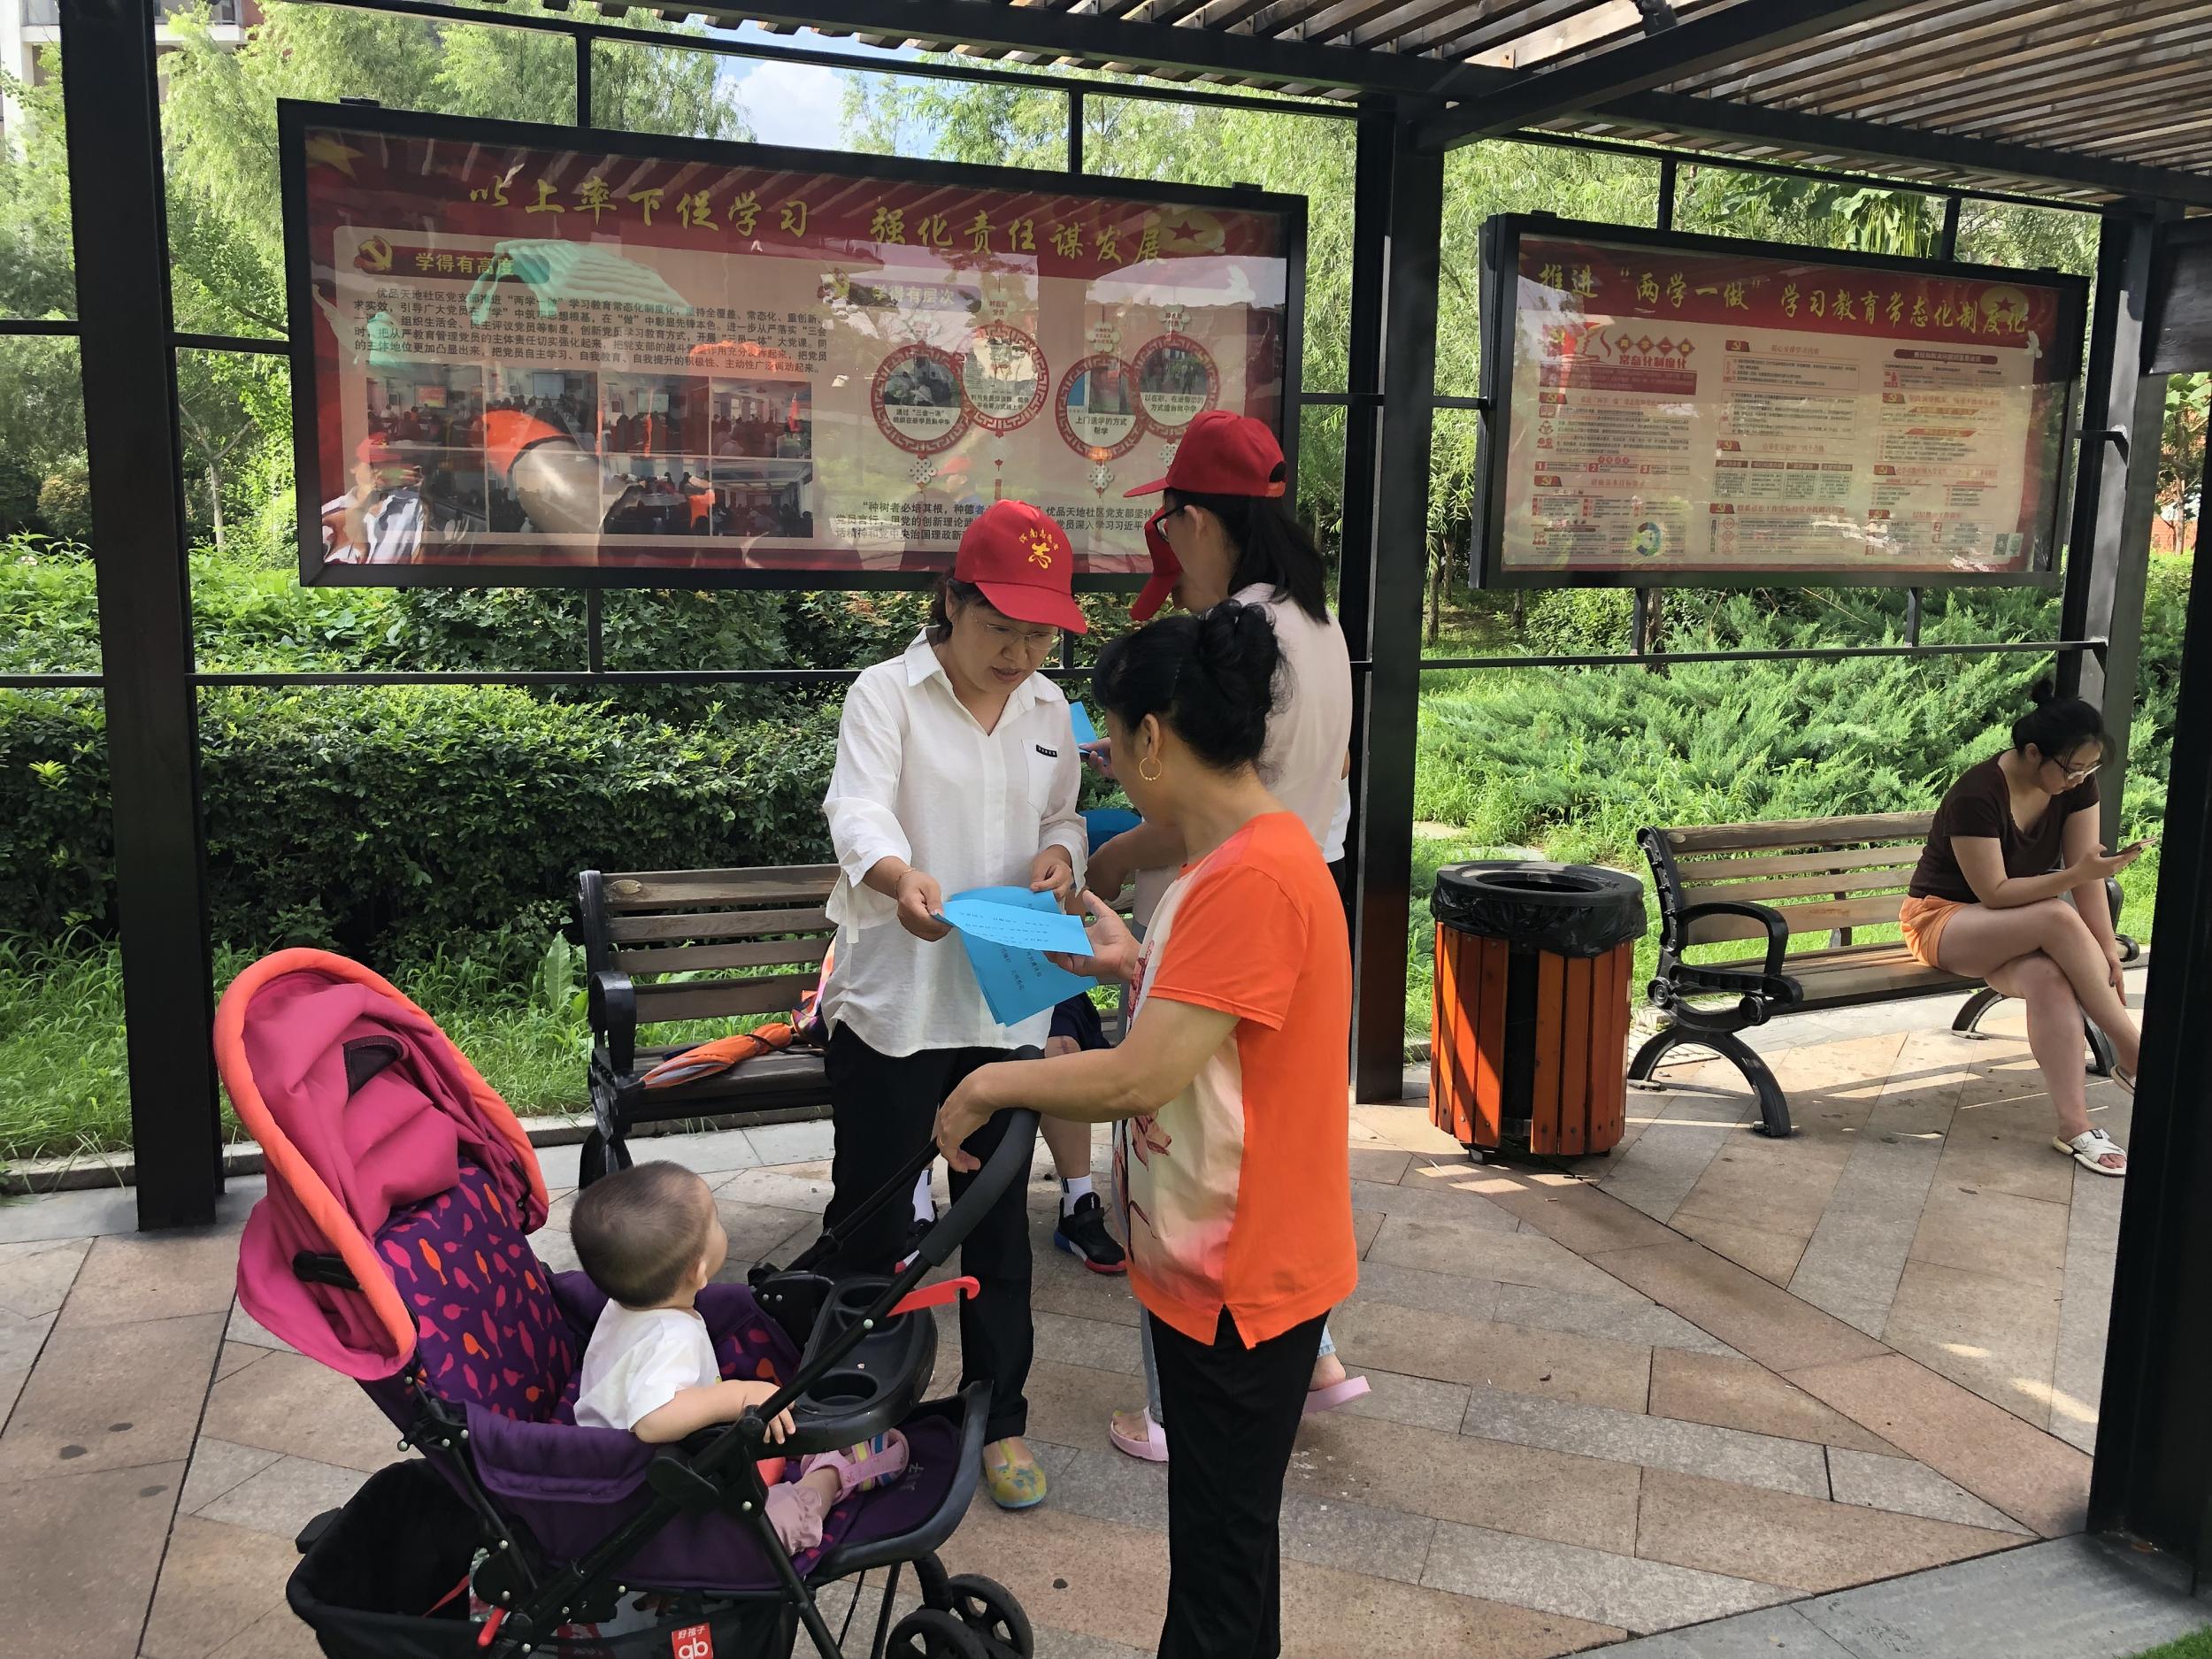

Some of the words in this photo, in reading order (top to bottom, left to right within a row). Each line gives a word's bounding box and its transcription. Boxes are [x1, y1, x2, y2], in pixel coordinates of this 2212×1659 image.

[470, 174, 807, 237] 以上率下促学习
[870, 206, 1163, 266] 强化责任谋发展
[416, 252, 513, 276] 学得有高度
[874, 283, 955, 305] 学得有层次
[863, 501, 989, 515] “种树者必培其根，种德者
[835, 526, 964, 541] 话精神和党中央治国理政新
[678, 1625, 705, 1640] 好孩子
[678, 1637, 709, 1659] gb
